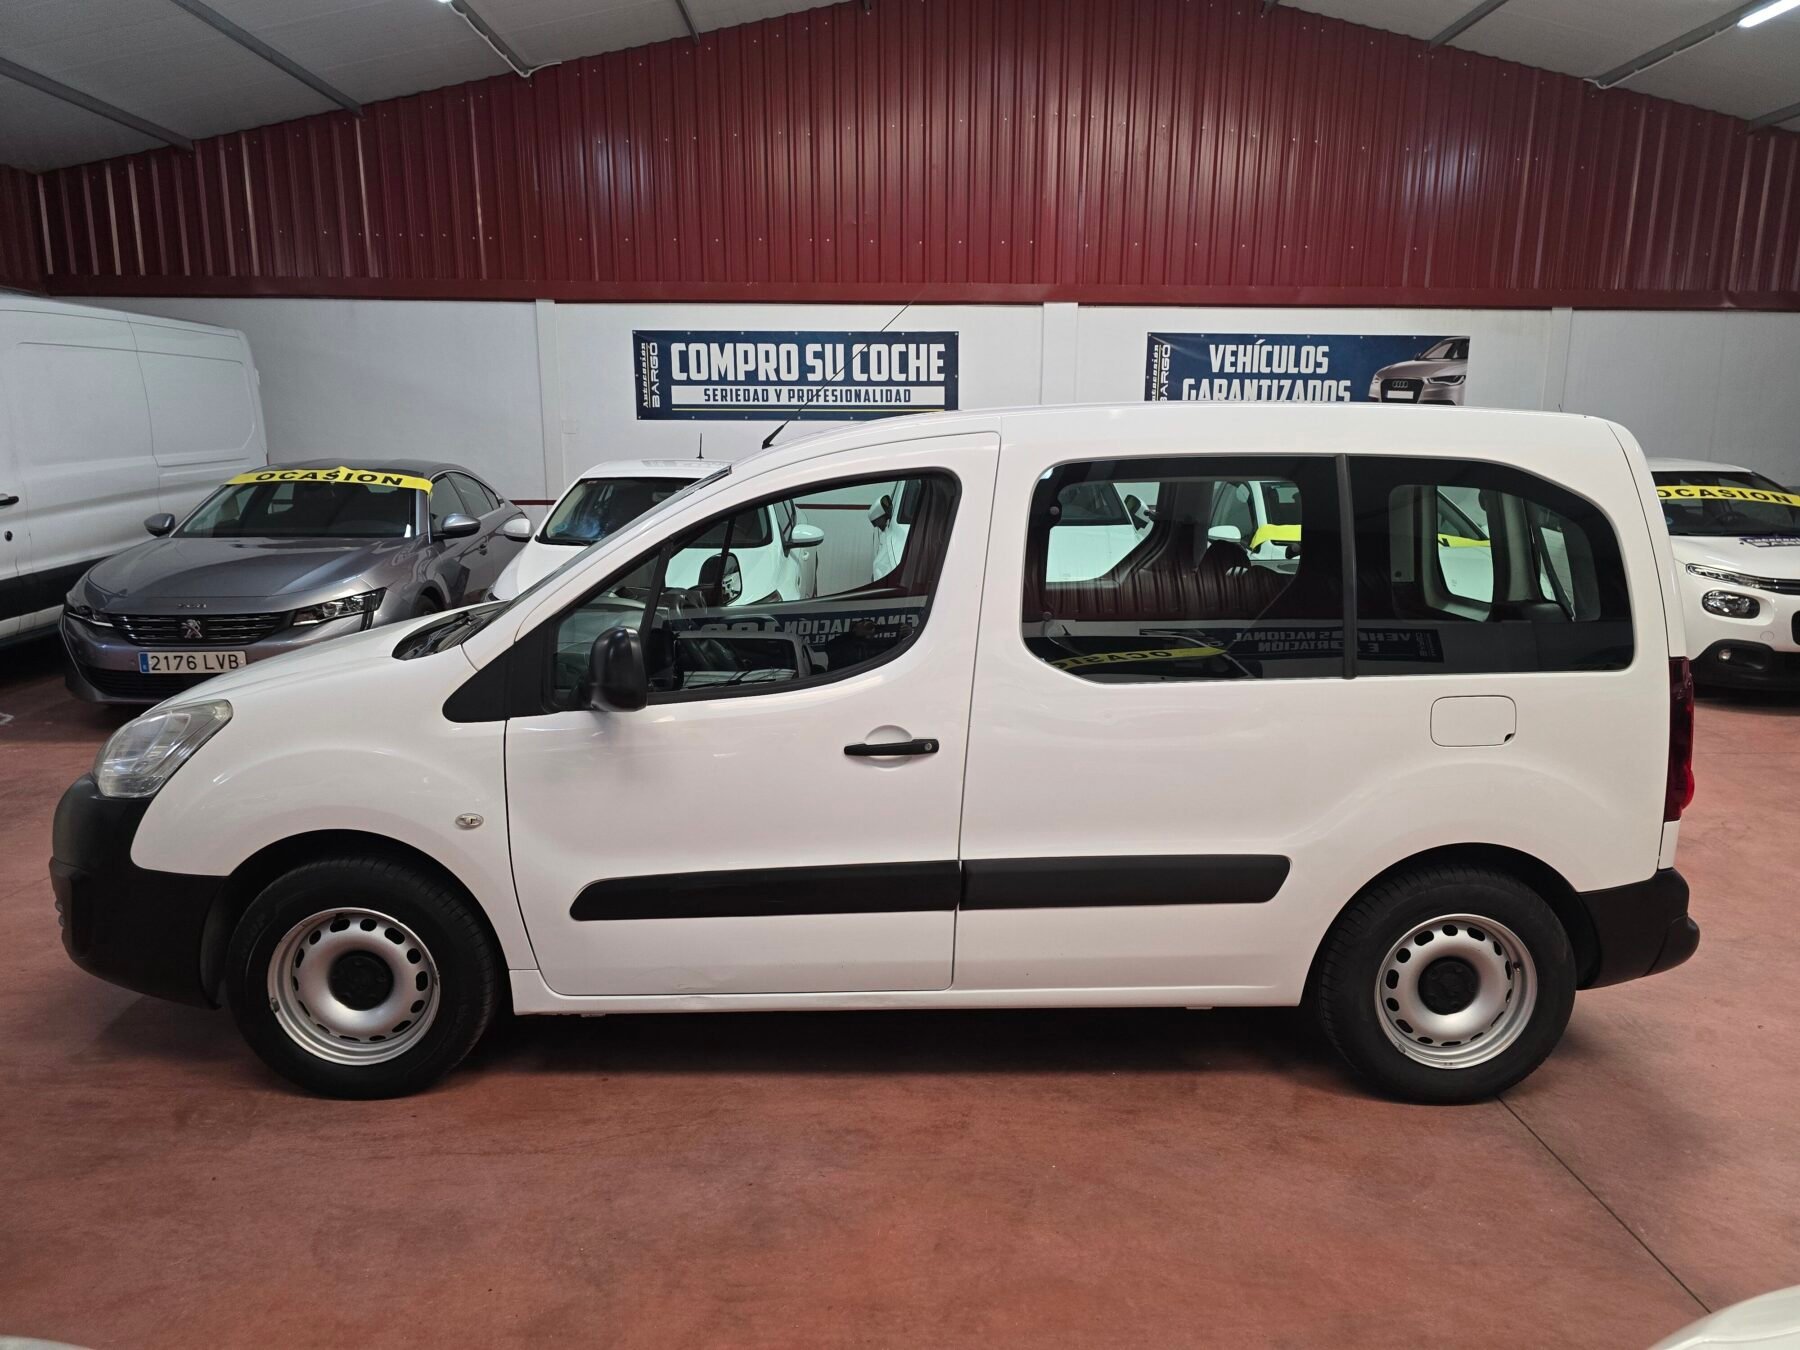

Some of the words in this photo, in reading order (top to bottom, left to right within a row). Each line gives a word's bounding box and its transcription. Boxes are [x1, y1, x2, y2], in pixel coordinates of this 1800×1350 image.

[670, 342, 799, 382] COMPRO
[807, 343, 844, 382] SU
[851, 343, 946, 383] COCHE
[1209, 339, 1330, 375] VEHÍCULOS
[649, 342, 661, 408] BARGO
[1151, 344, 1159, 401] utocasión
[703, 387, 770, 403] SERIEDAD
[774, 387, 783, 403] Y
[787, 387, 912, 404] PROFESIONALIDAD
[1182, 378, 1352, 402] GARANTIZADOS
[255, 470, 403, 486] OCASION
[1656, 488, 1794, 504] OCASION
[150, 655, 198, 671] 2176
[203, 654, 239, 670] LVB
